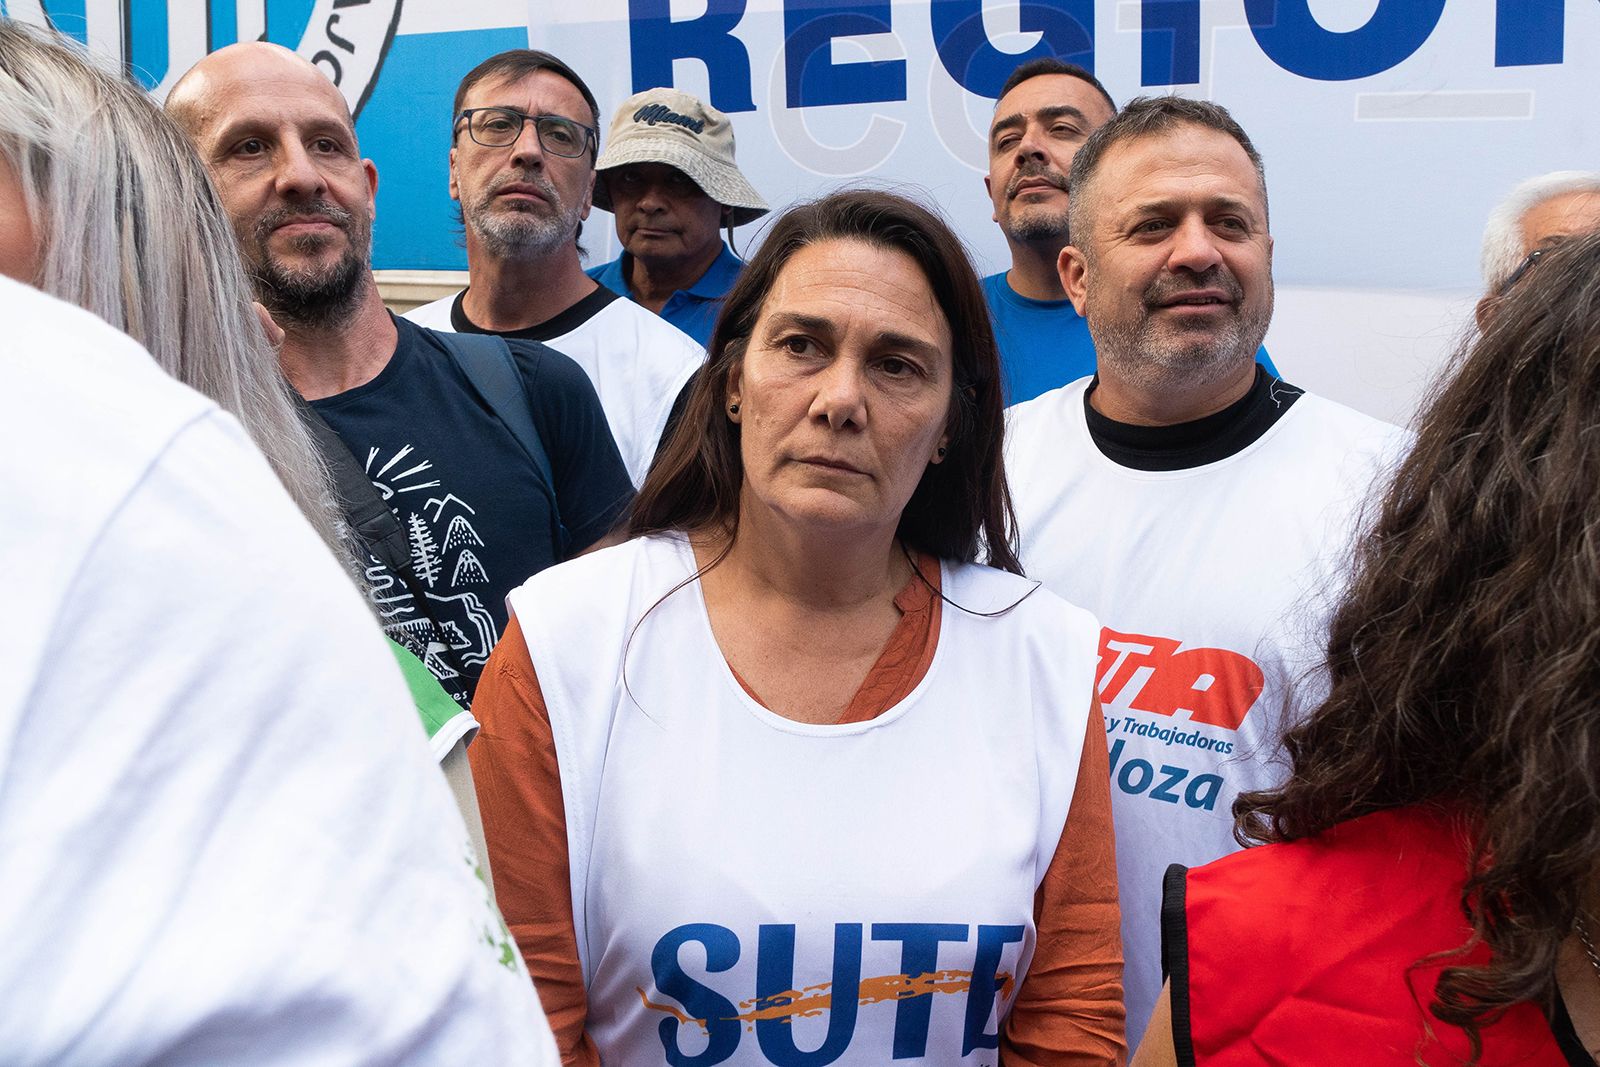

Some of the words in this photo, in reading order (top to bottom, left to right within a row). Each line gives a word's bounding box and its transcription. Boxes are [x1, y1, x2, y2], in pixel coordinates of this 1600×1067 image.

[627, 0, 1565, 113] REGIO
[1106, 718, 1121, 733] y
[1123, 716, 1234, 754] Trabajadoras
[651, 922, 1025, 1067] SUTE
